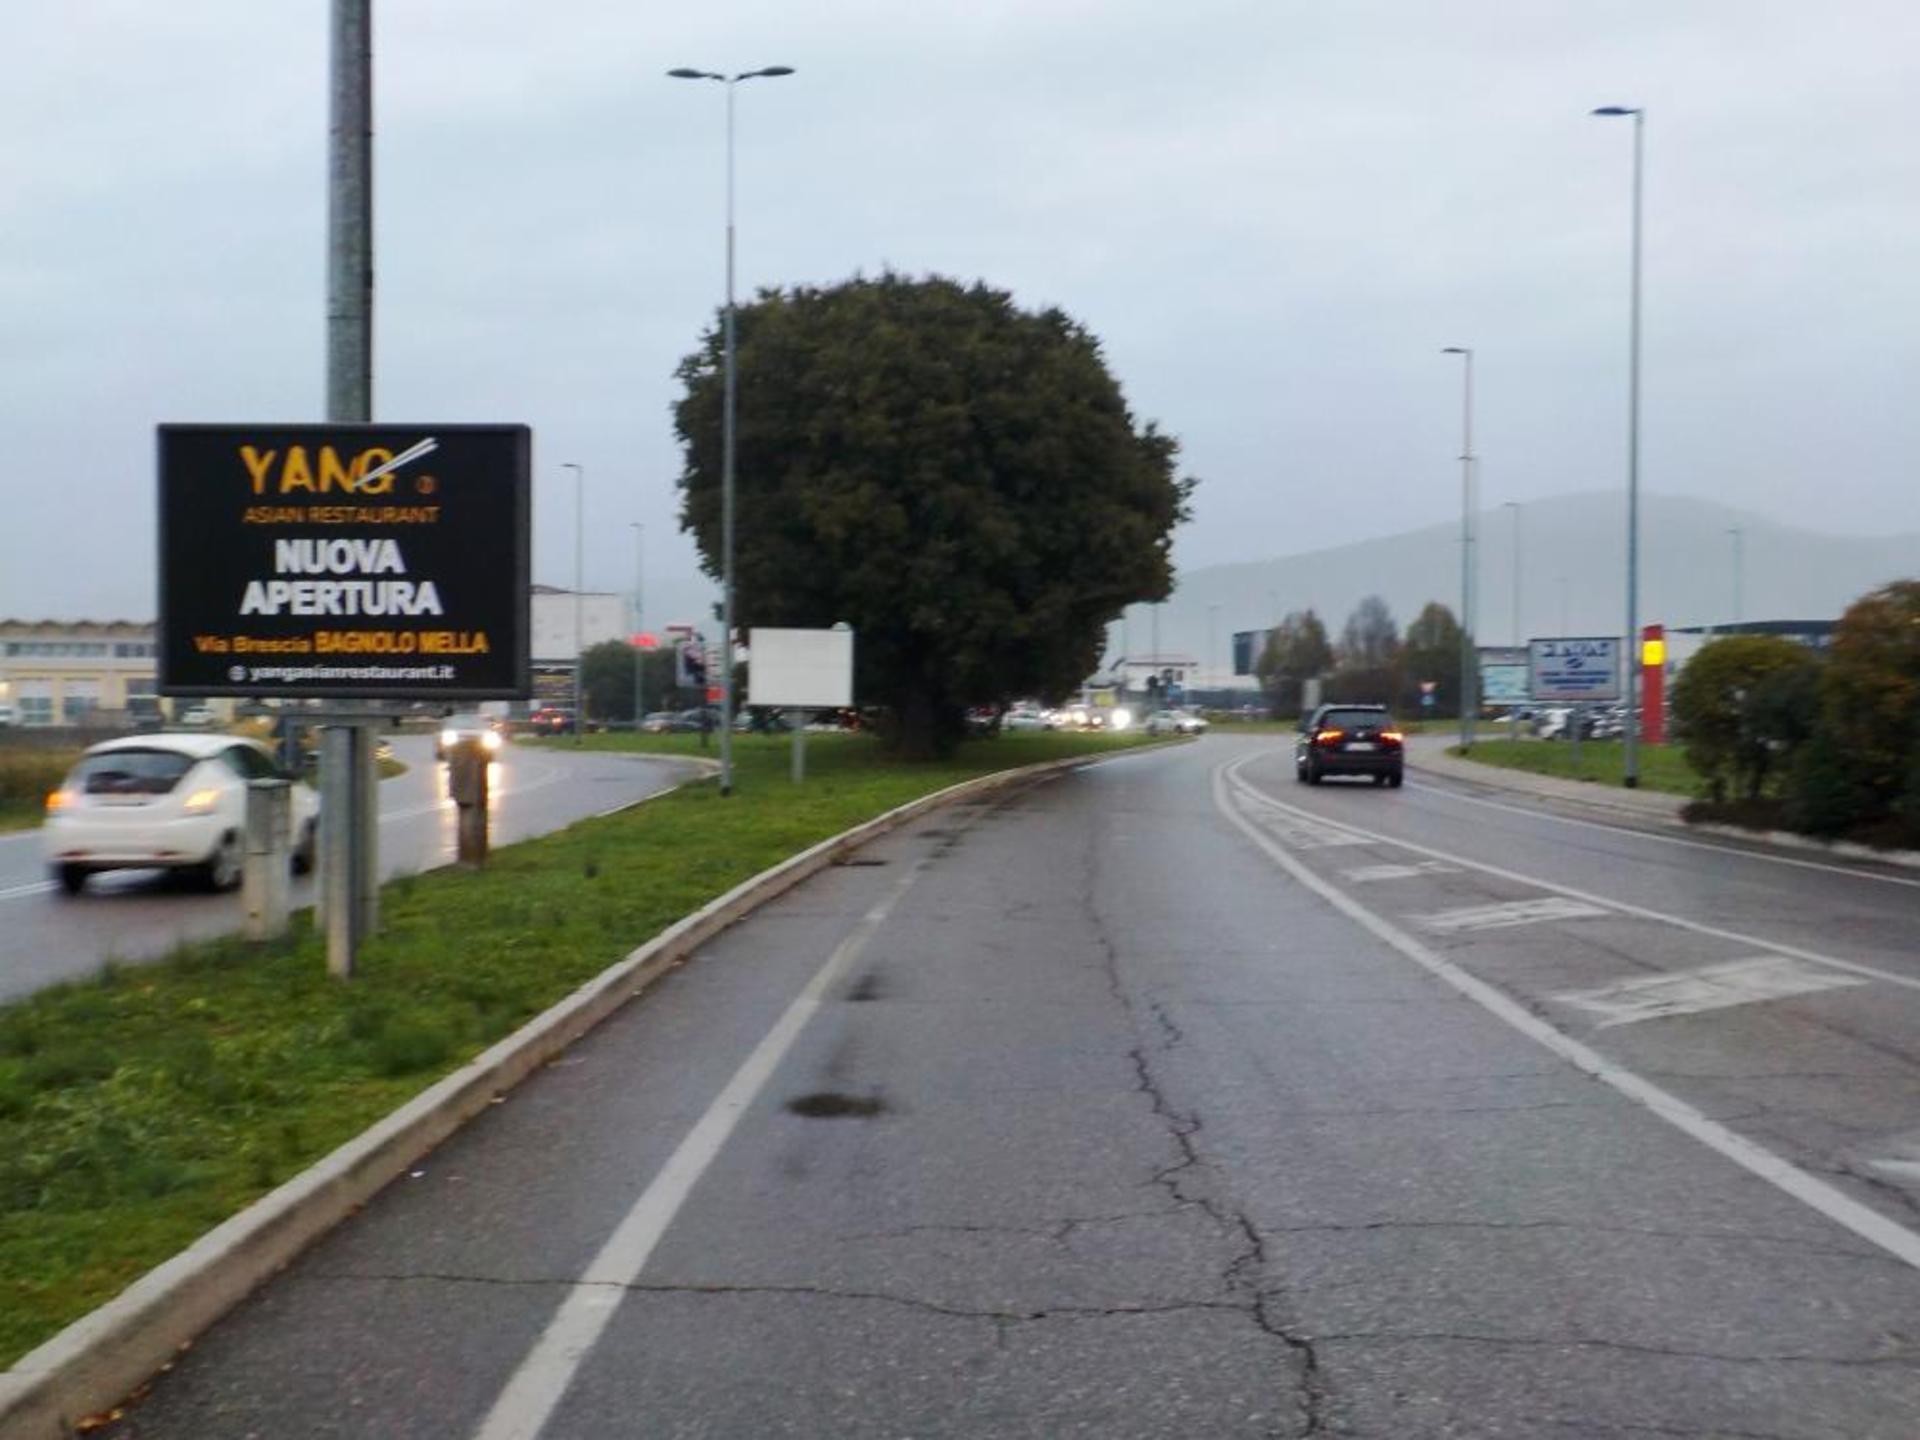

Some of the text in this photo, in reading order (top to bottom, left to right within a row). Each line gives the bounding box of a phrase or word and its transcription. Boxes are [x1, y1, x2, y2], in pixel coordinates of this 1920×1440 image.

[239, 444, 398, 495] YANG
[242, 506, 441, 524] ASIAN RESTAURANT
[275, 539, 405, 574] NUOVA
[239, 580, 444, 616] APERTURA
[194, 632, 489, 654] Via Brescia BAGNOLO MELLA
[249, 664, 455, 683] yangasianrestaurant.it
